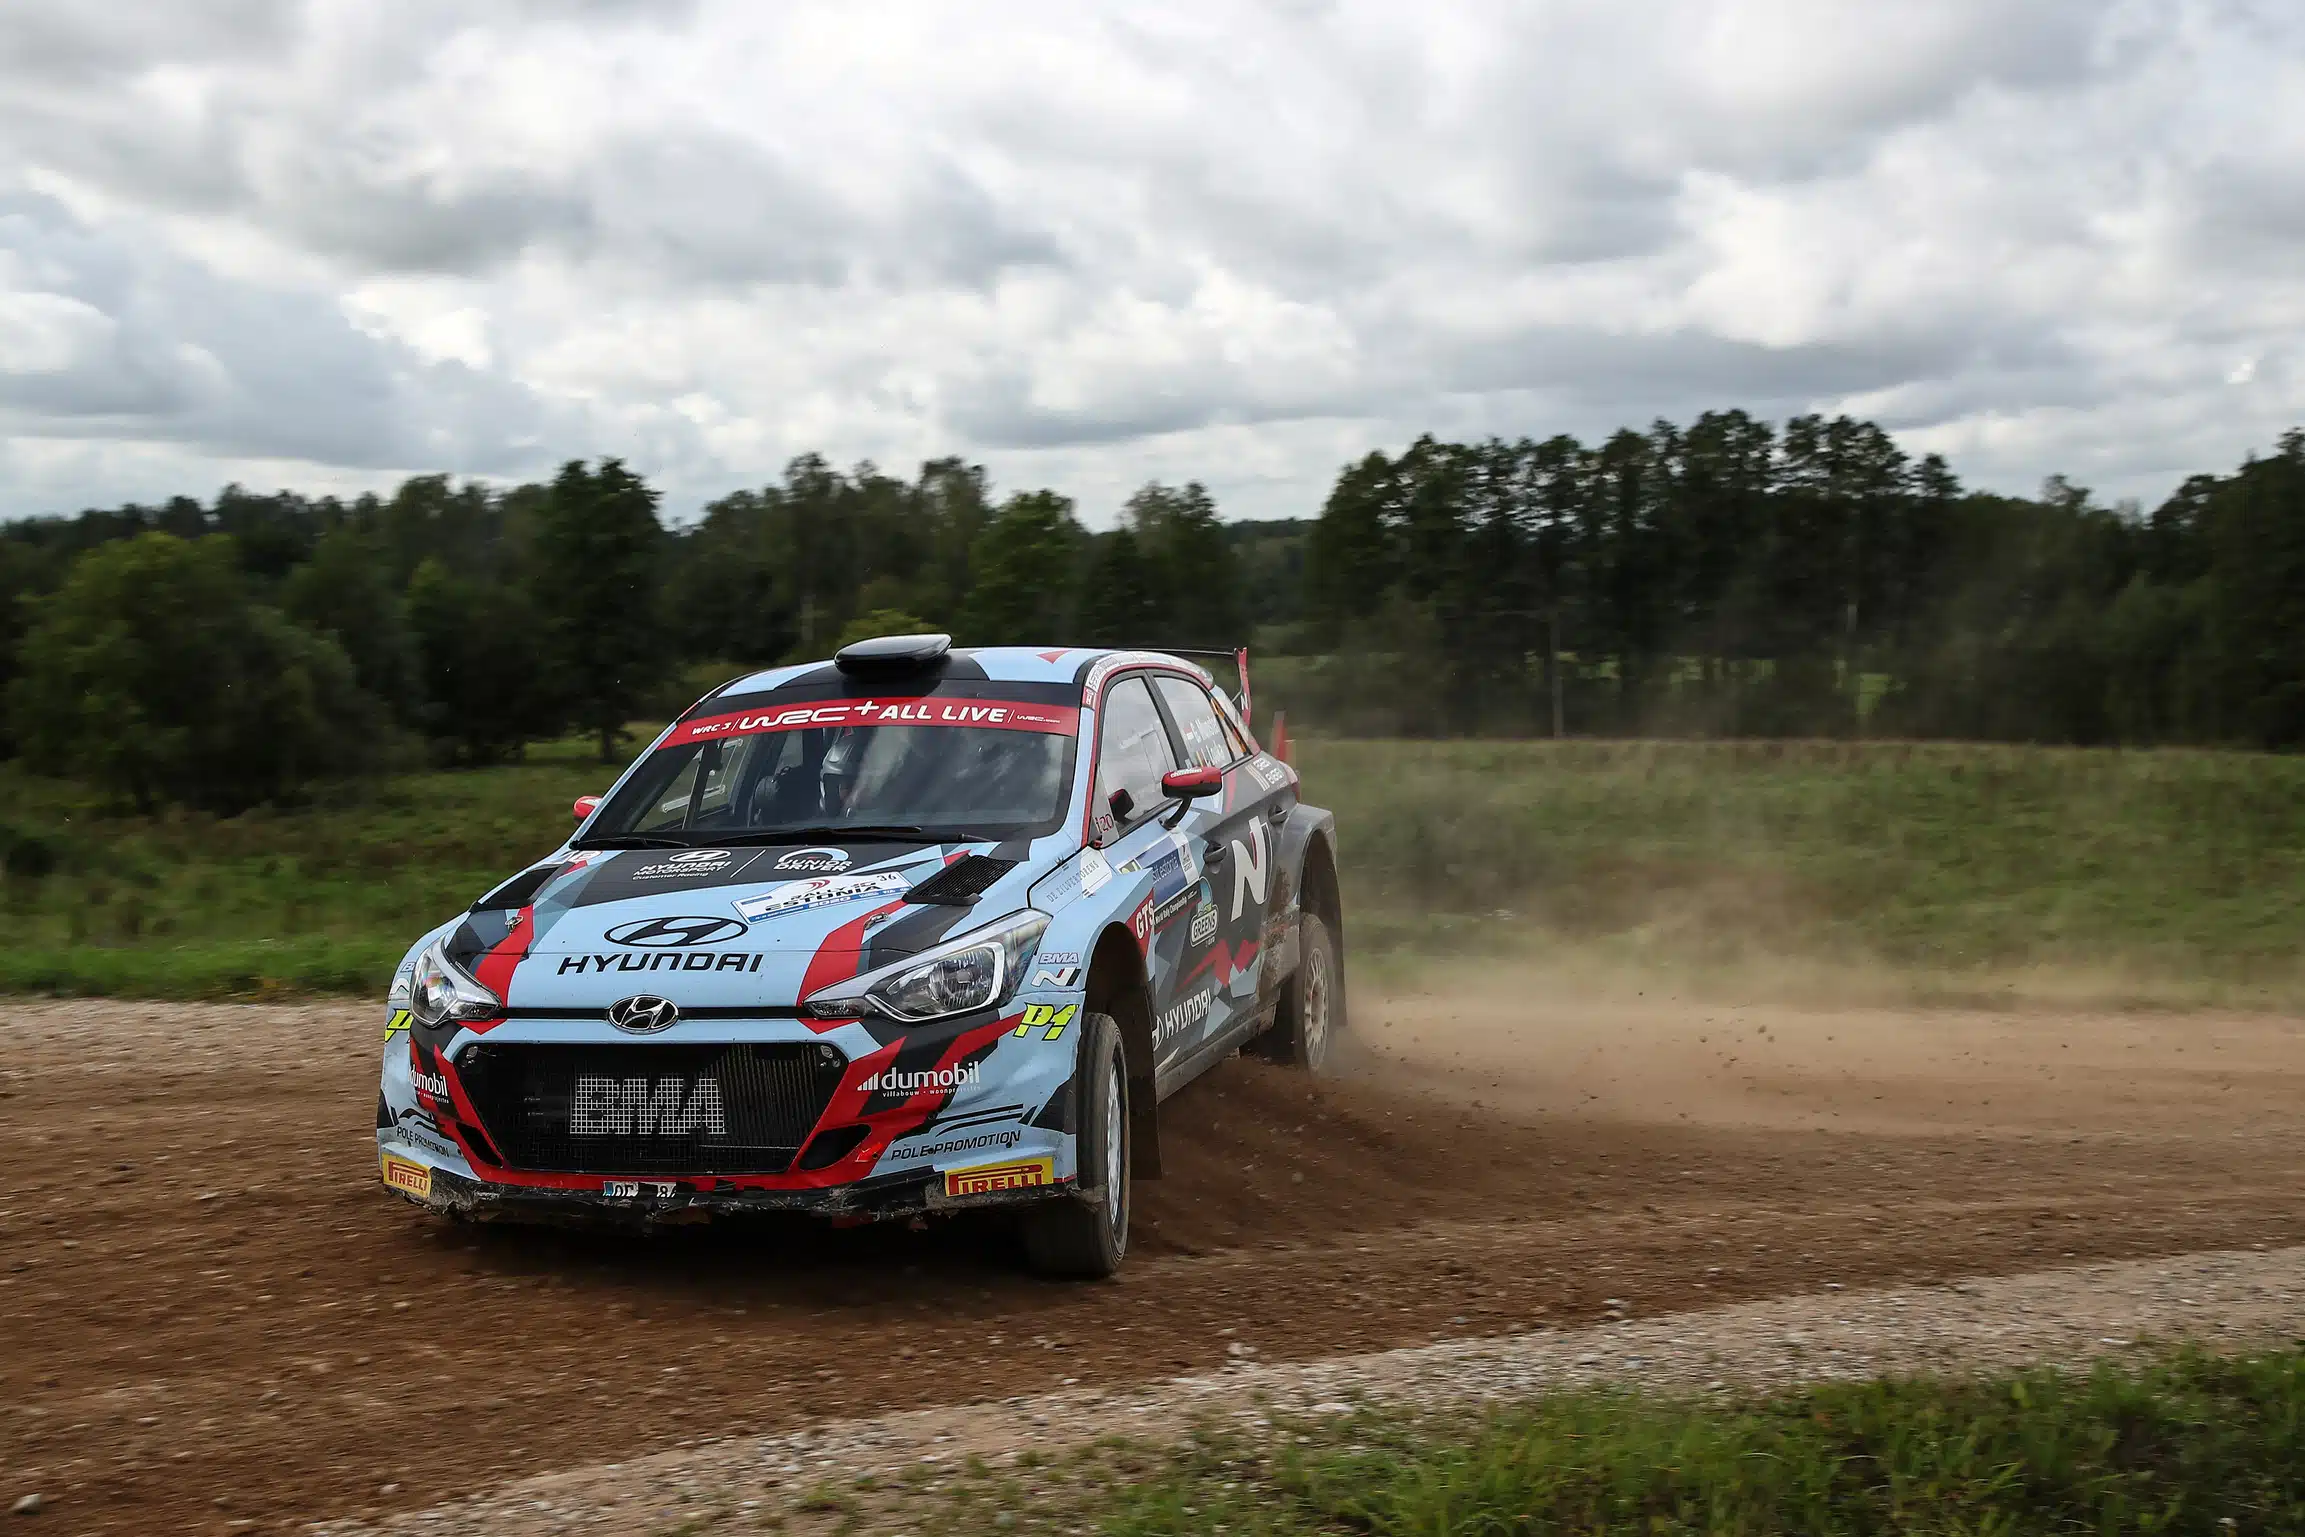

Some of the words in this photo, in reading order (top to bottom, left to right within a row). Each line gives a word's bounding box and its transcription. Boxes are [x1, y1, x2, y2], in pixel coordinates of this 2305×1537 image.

[878, 704, 932, 720] ALL
[941, 706, 1008, 723] LIVE
[692, 725, 718, 735] WRC
[722, 722, 732, 731] 3
[1094, 813, 1115, 834] i20
[633, 866, 726, 876] MOTORSPORT
[640, 861, 732, 871] HYUNDAI
[773, 863, 848, 872] DRIVER
[779, 858, 853, 867] JUNIOR
[876, 873, 897, 882] 36
[765, 885, 884, 912] ESTONIA
[1046, 892, 1058, 904] DE
[1135, 899, 1154, 940] GTS
[1193, 913, 1216, 939] GREENS
[557, 953, 764, 976] HYUNDAI
[1038, 952, 1080, 965] BMA
[1013, 1002, 1080, 1041] P1
[1165, 988, 1211, 1039] HYUNDAI
[881, 1061, 980, 1091] dumobil
[570, 1076, 727, 1134] BMA
[882, 1089, 920, 1099] villabouw
[396, 1126, 415, 1143] POLE
[415, 1133, 450, 1158] PROMOTION
[891, 1146, 929, 1161] POLE
[933, 1130, 1021, 1155] PROMOTION
[387, 1160, 428, 1194] PIRELLI
[948, 1164, 1044, 1196] PIRELLI
